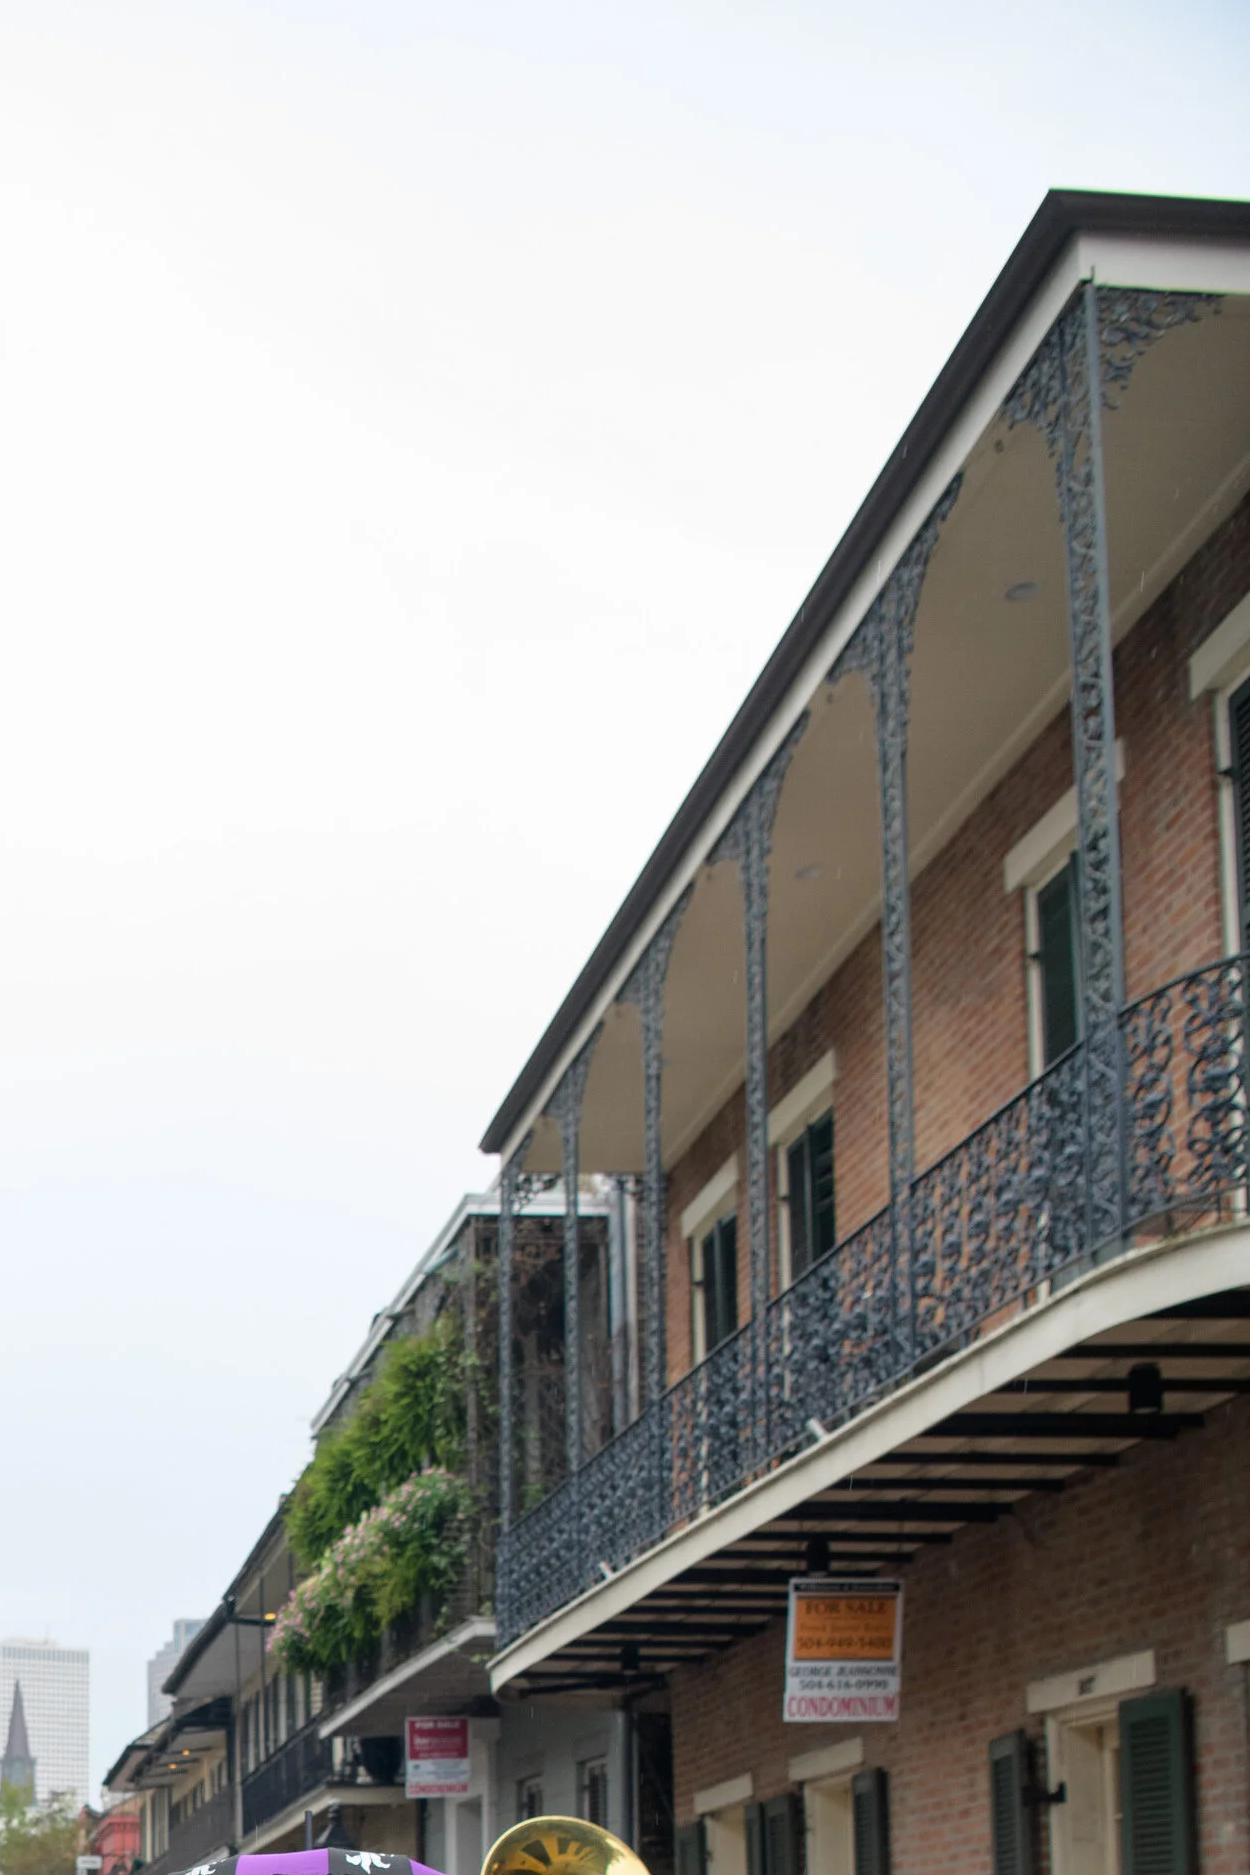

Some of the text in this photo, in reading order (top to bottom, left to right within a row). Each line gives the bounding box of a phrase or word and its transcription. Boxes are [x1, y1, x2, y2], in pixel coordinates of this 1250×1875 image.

[805, 1600, 887, 1615] FOR SALE
[787, 1696, 898, 1718] CONDOMINIUM
